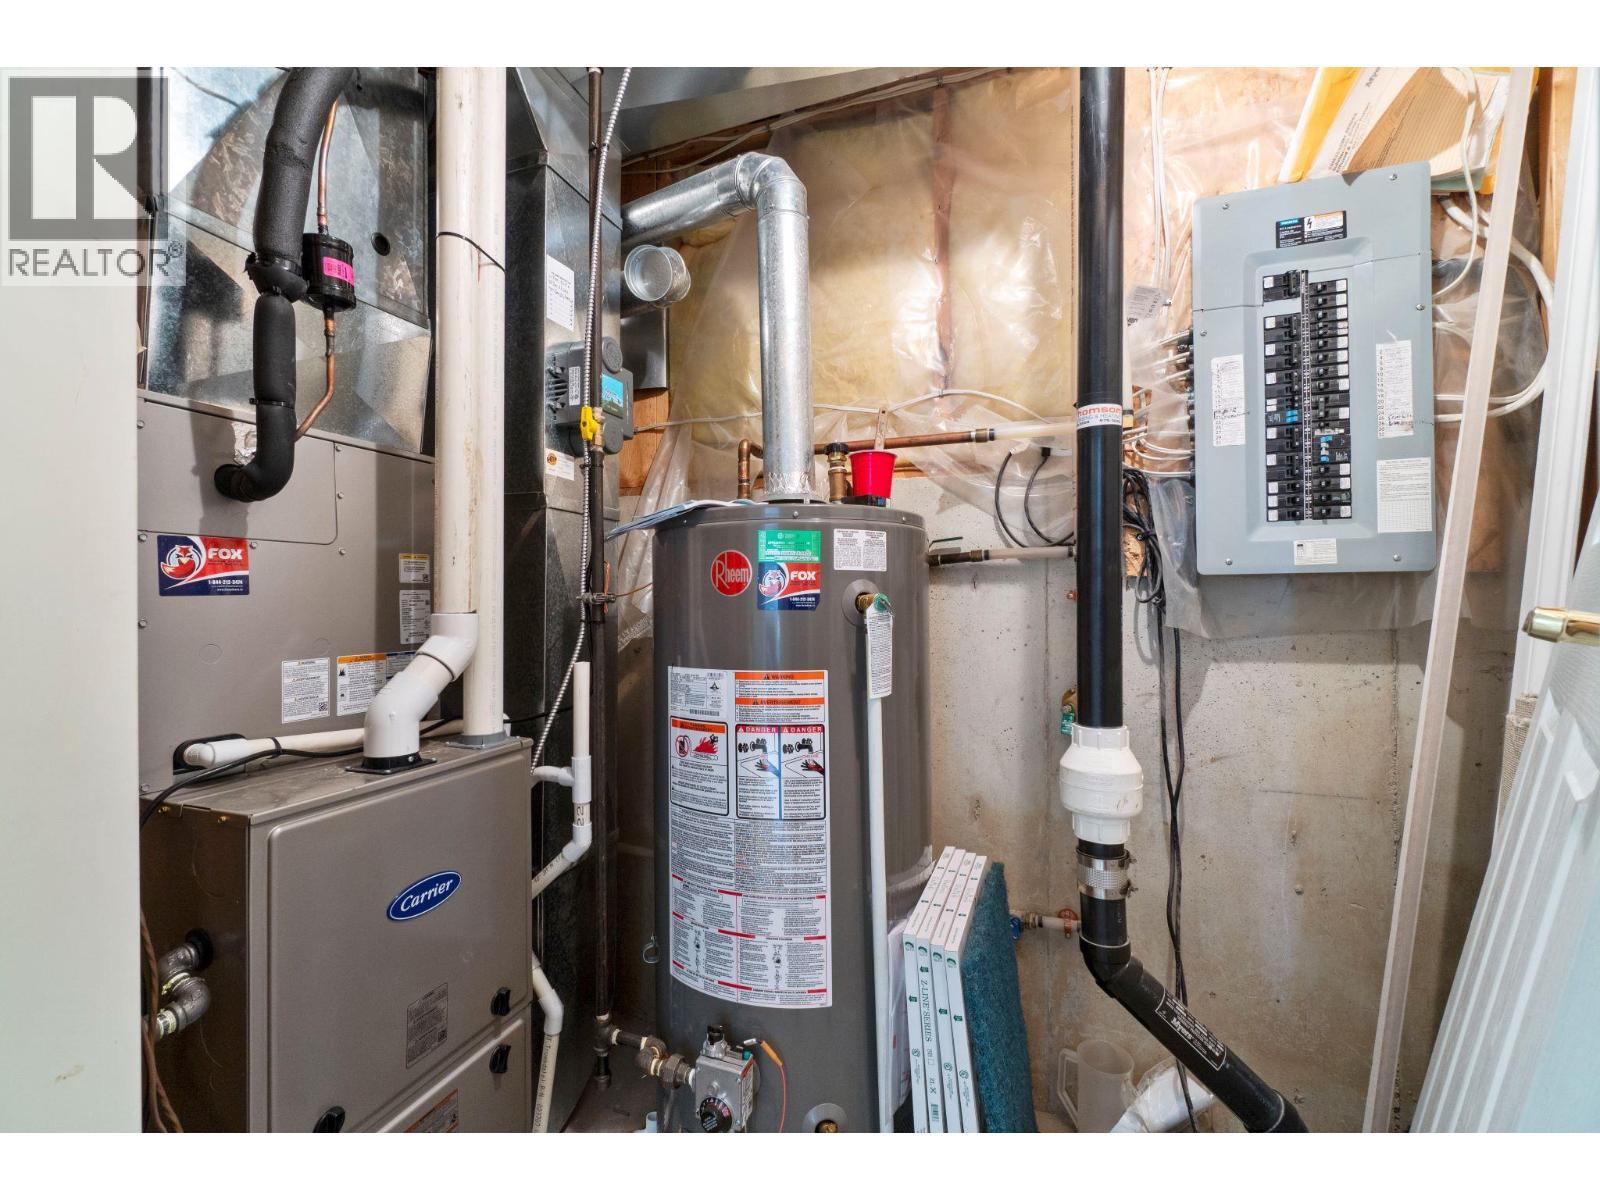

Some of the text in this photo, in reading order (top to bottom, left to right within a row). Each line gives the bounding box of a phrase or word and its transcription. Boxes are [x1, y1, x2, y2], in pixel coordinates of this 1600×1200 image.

[208, 548, 243, 560] FOX
[715, 552, 749, 590] Rheem
[790, 571, 817, 581] FOX
[400, 879, 453, 912] Carrier
[922, 1010, 932, 1042] SERIES
